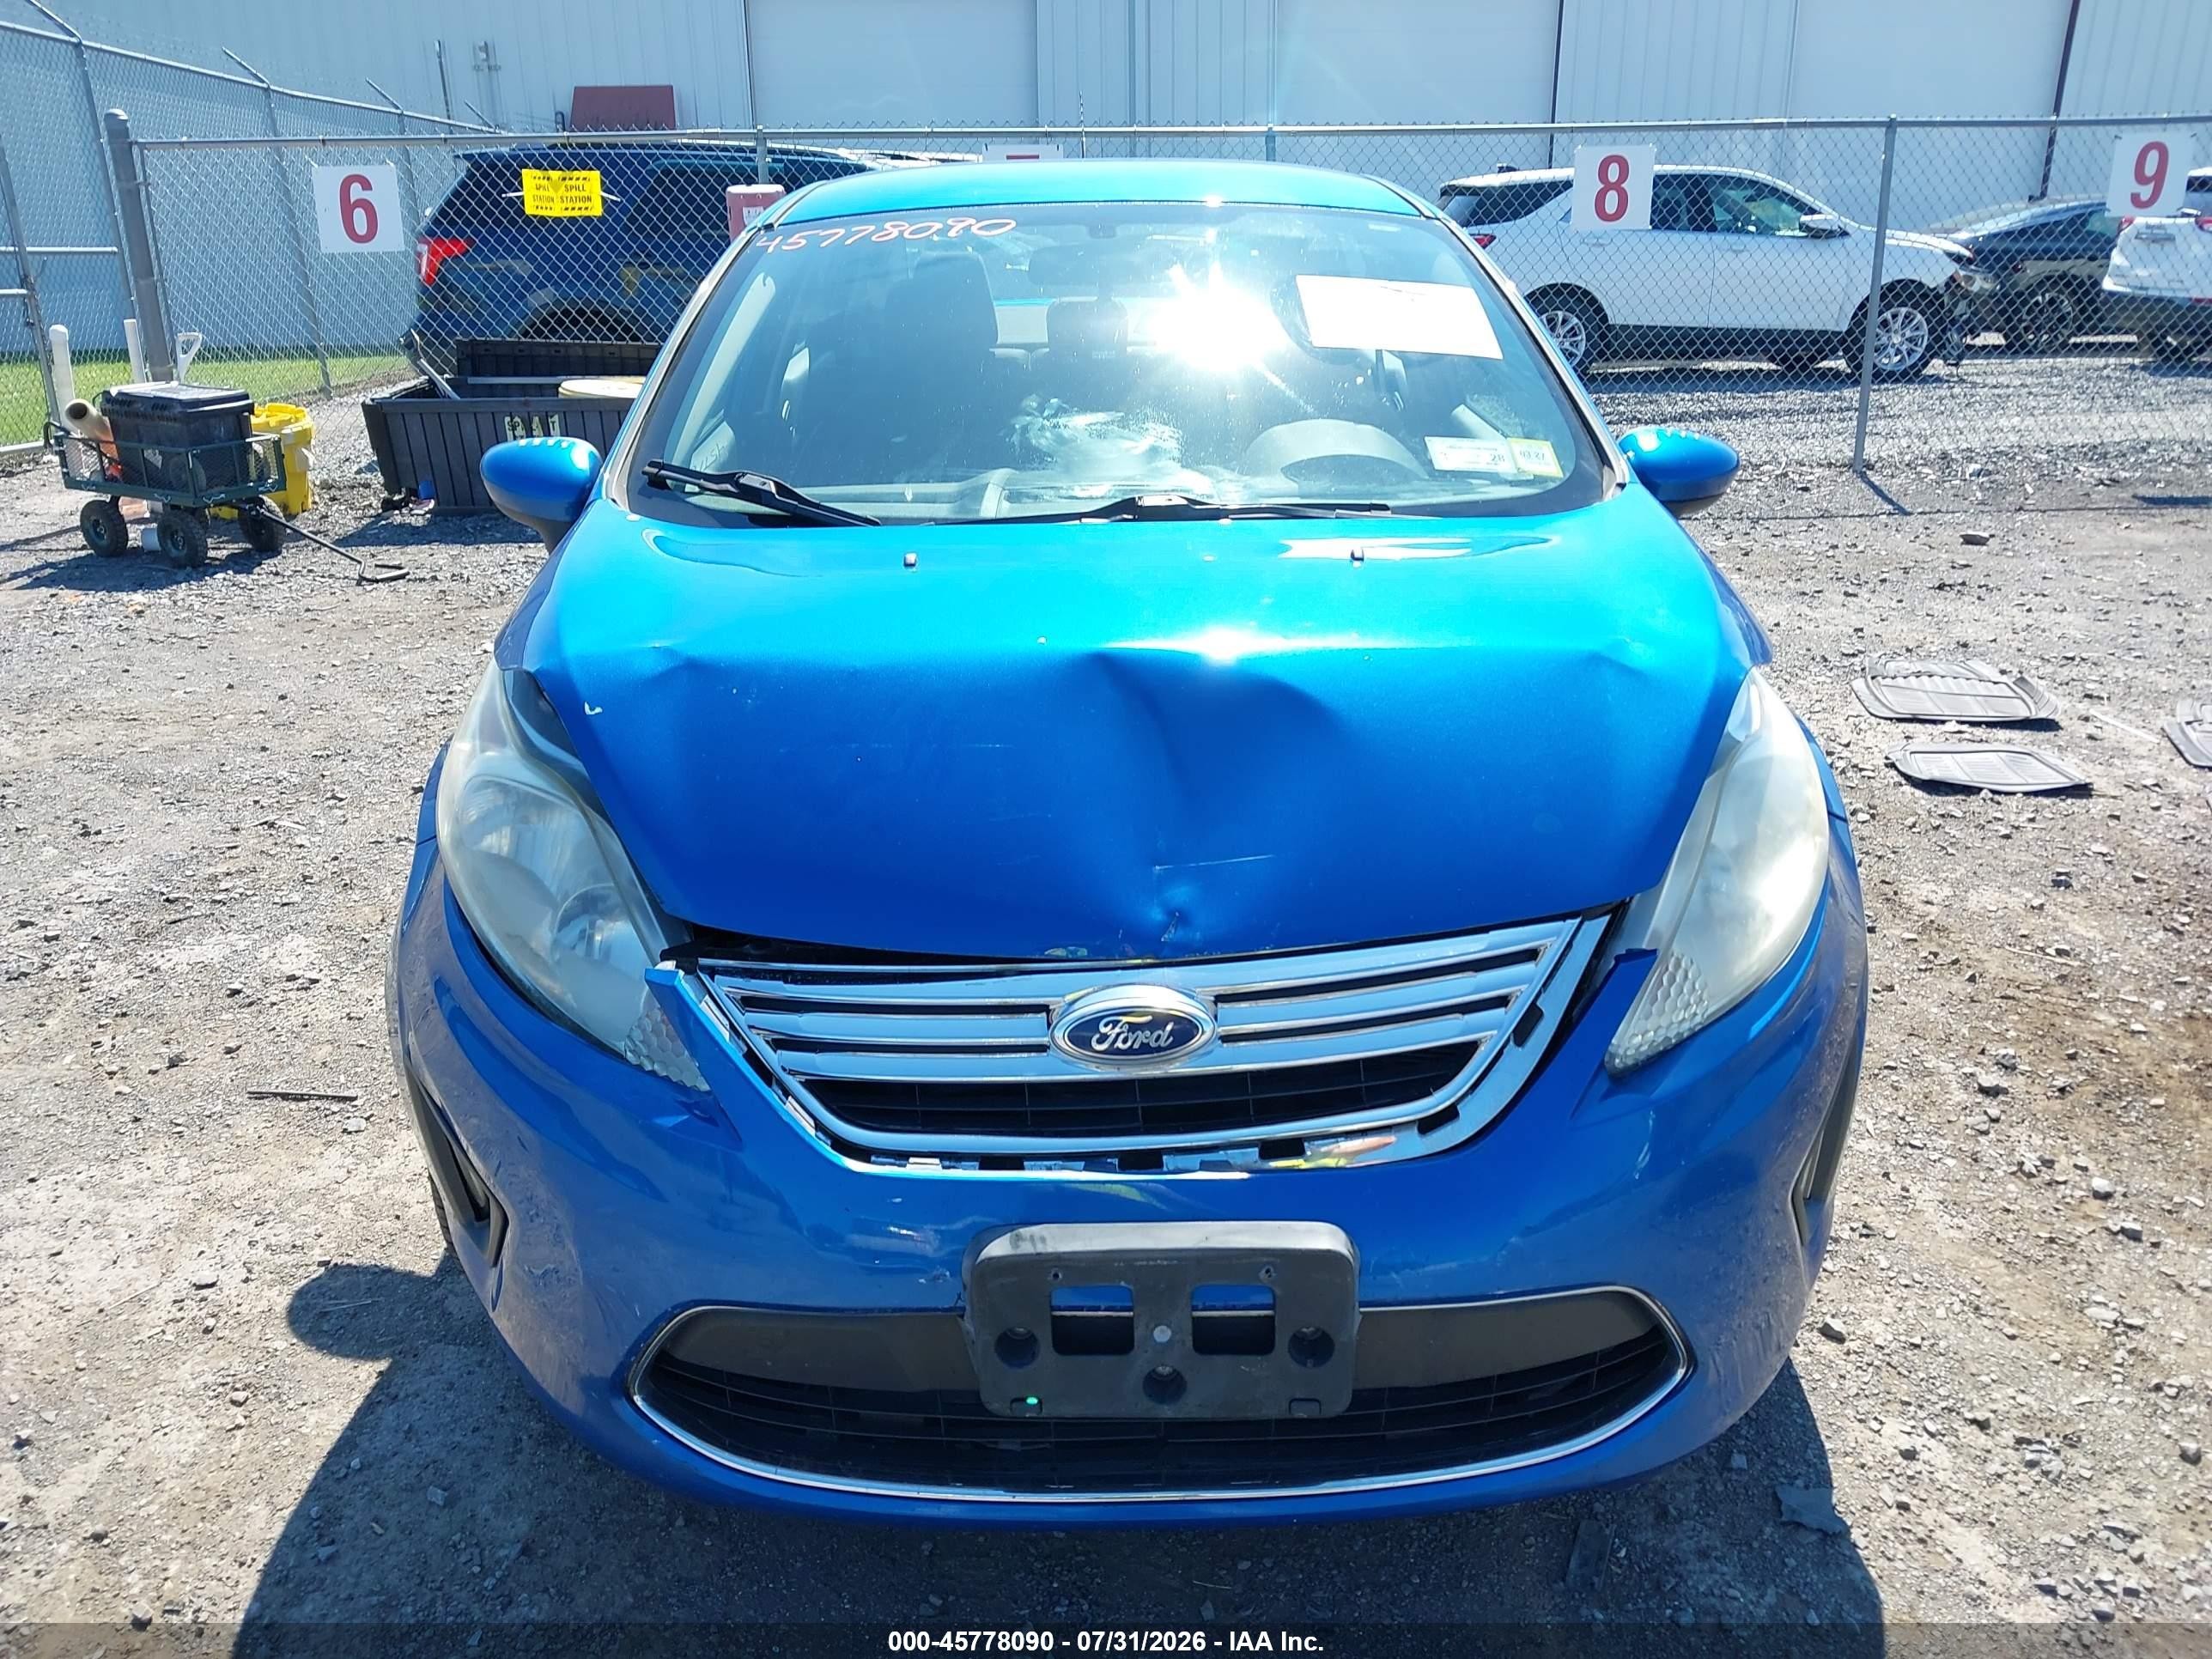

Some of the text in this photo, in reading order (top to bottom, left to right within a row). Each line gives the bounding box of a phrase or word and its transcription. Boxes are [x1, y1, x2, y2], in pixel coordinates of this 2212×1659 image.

[564, 184, 586, 192] SPILL
[1595, 155, 1630, 222] 8
[2130, 141, 2169, 210] 9
[339, 173, 379, 244] 6
[532, 194, 555, 204] STATION
[560, 195, 592, 204] STATION
[1091, 1015, 1175, 1051] Ford
